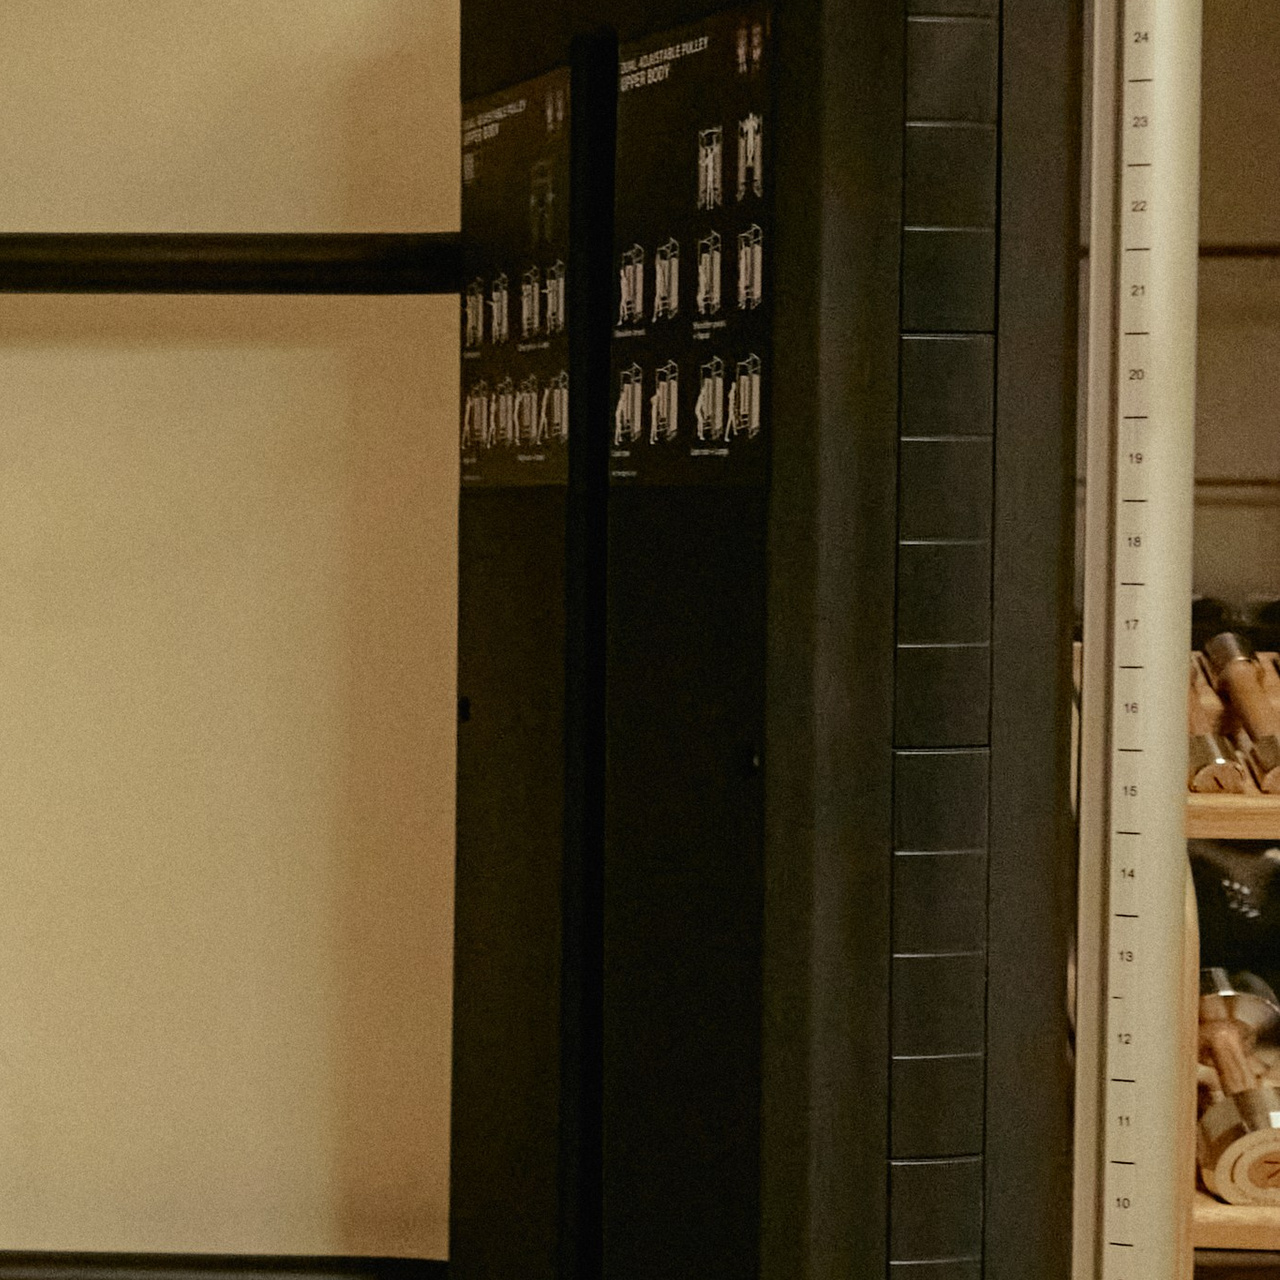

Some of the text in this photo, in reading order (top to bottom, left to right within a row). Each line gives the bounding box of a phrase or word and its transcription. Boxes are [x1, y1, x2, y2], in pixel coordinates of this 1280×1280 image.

[1134, 32, 1149, 43] 24
[1132, 116, 1148, 128] 23
[1132, 200, 1147, 212] 22
[1131, 285, 1145, 297] 21
[1129, 369, 1145, 380] 20
[1129, 453, 1143, 464] 19
[1128, 536, 1141, 547] 18
[1125, 619, 1139, 630] 17
[1124, 702, 1138, 714] 16
[1123, 785, 1137, 797] 15
[1121, 868, 1135, 879] 14
[1119, 951, 1133, 962] 13
[1117, 1033, 1132, 1045] 12
[1118, 1116, 1130, 1126] 11
[1116, 1197, 1130, 1209] 10
